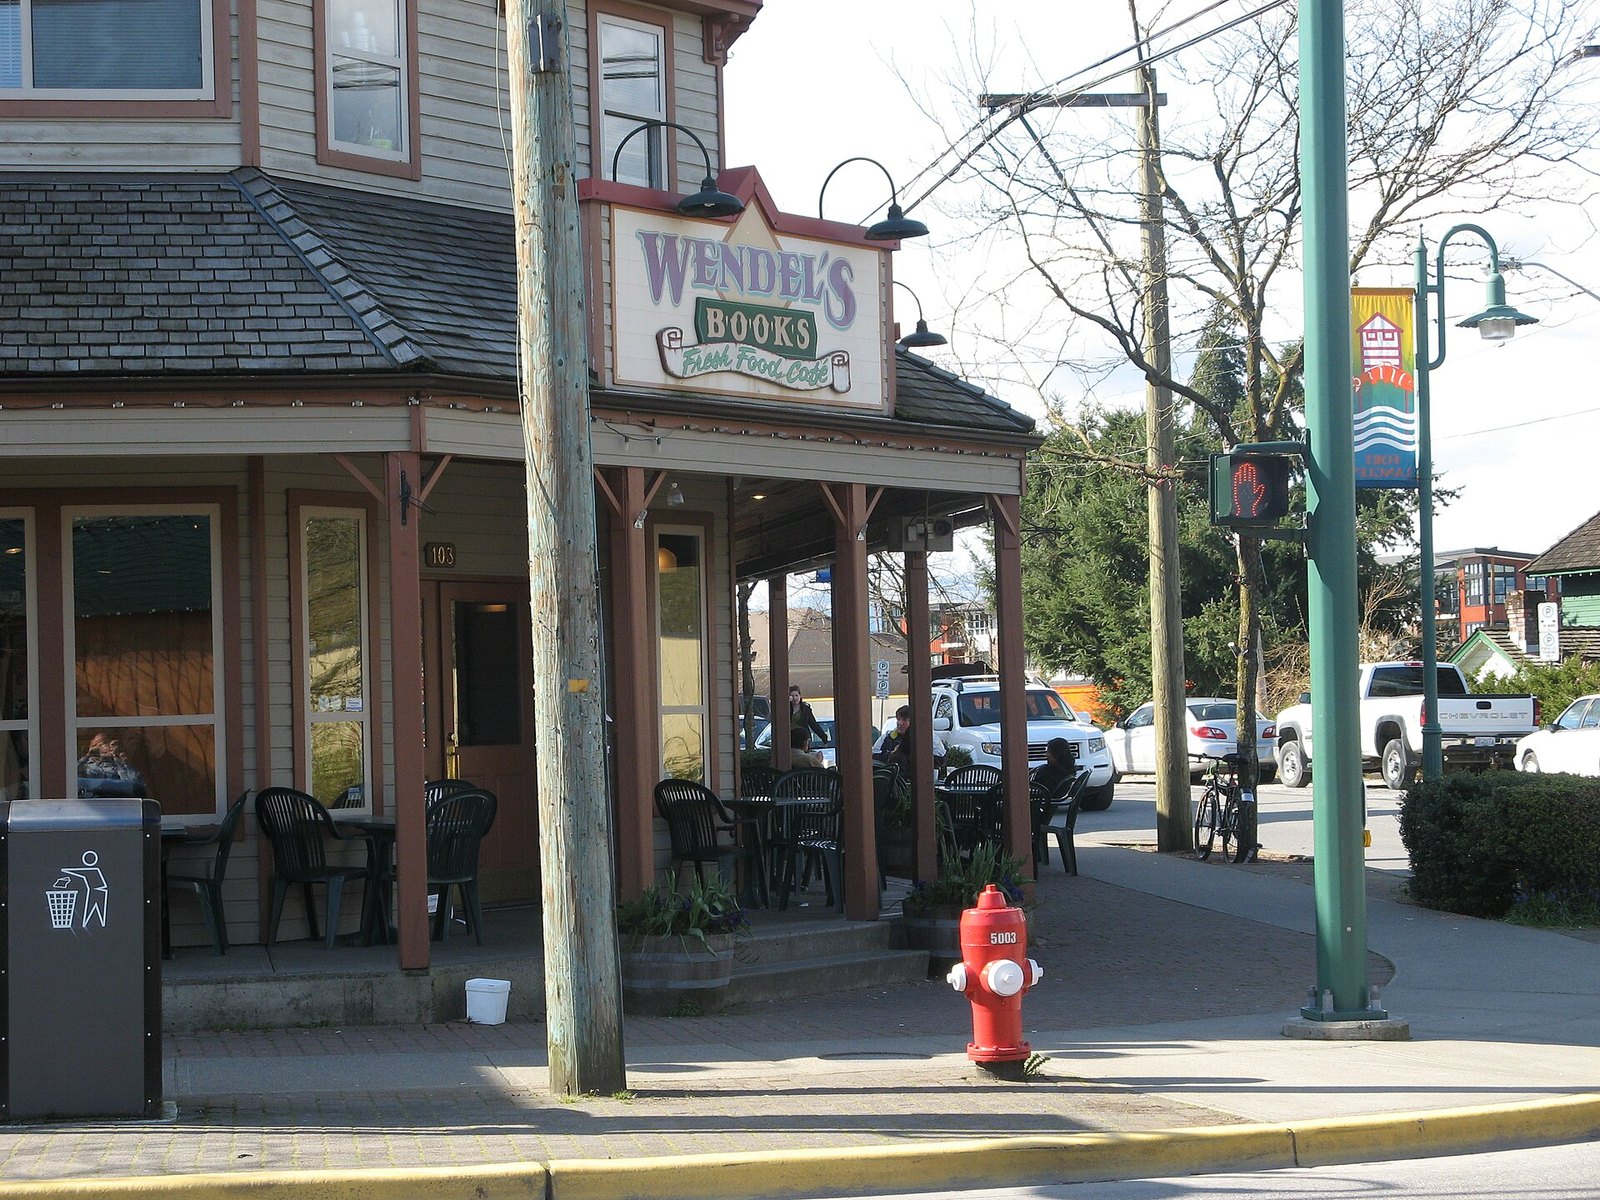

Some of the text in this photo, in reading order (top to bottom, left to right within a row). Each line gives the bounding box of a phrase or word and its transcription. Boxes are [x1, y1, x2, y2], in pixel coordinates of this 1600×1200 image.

[636, 229, 857, 331] WENDEL'S
[706, 307, 810, 350] BOOKS
[682, 345, 829, 386] Fresh Food Café
[432, 546, 454, 565] 103
[1439, 712, 1528, 720] CHEVROLET
[990, 932, 1017, 945] 5003
